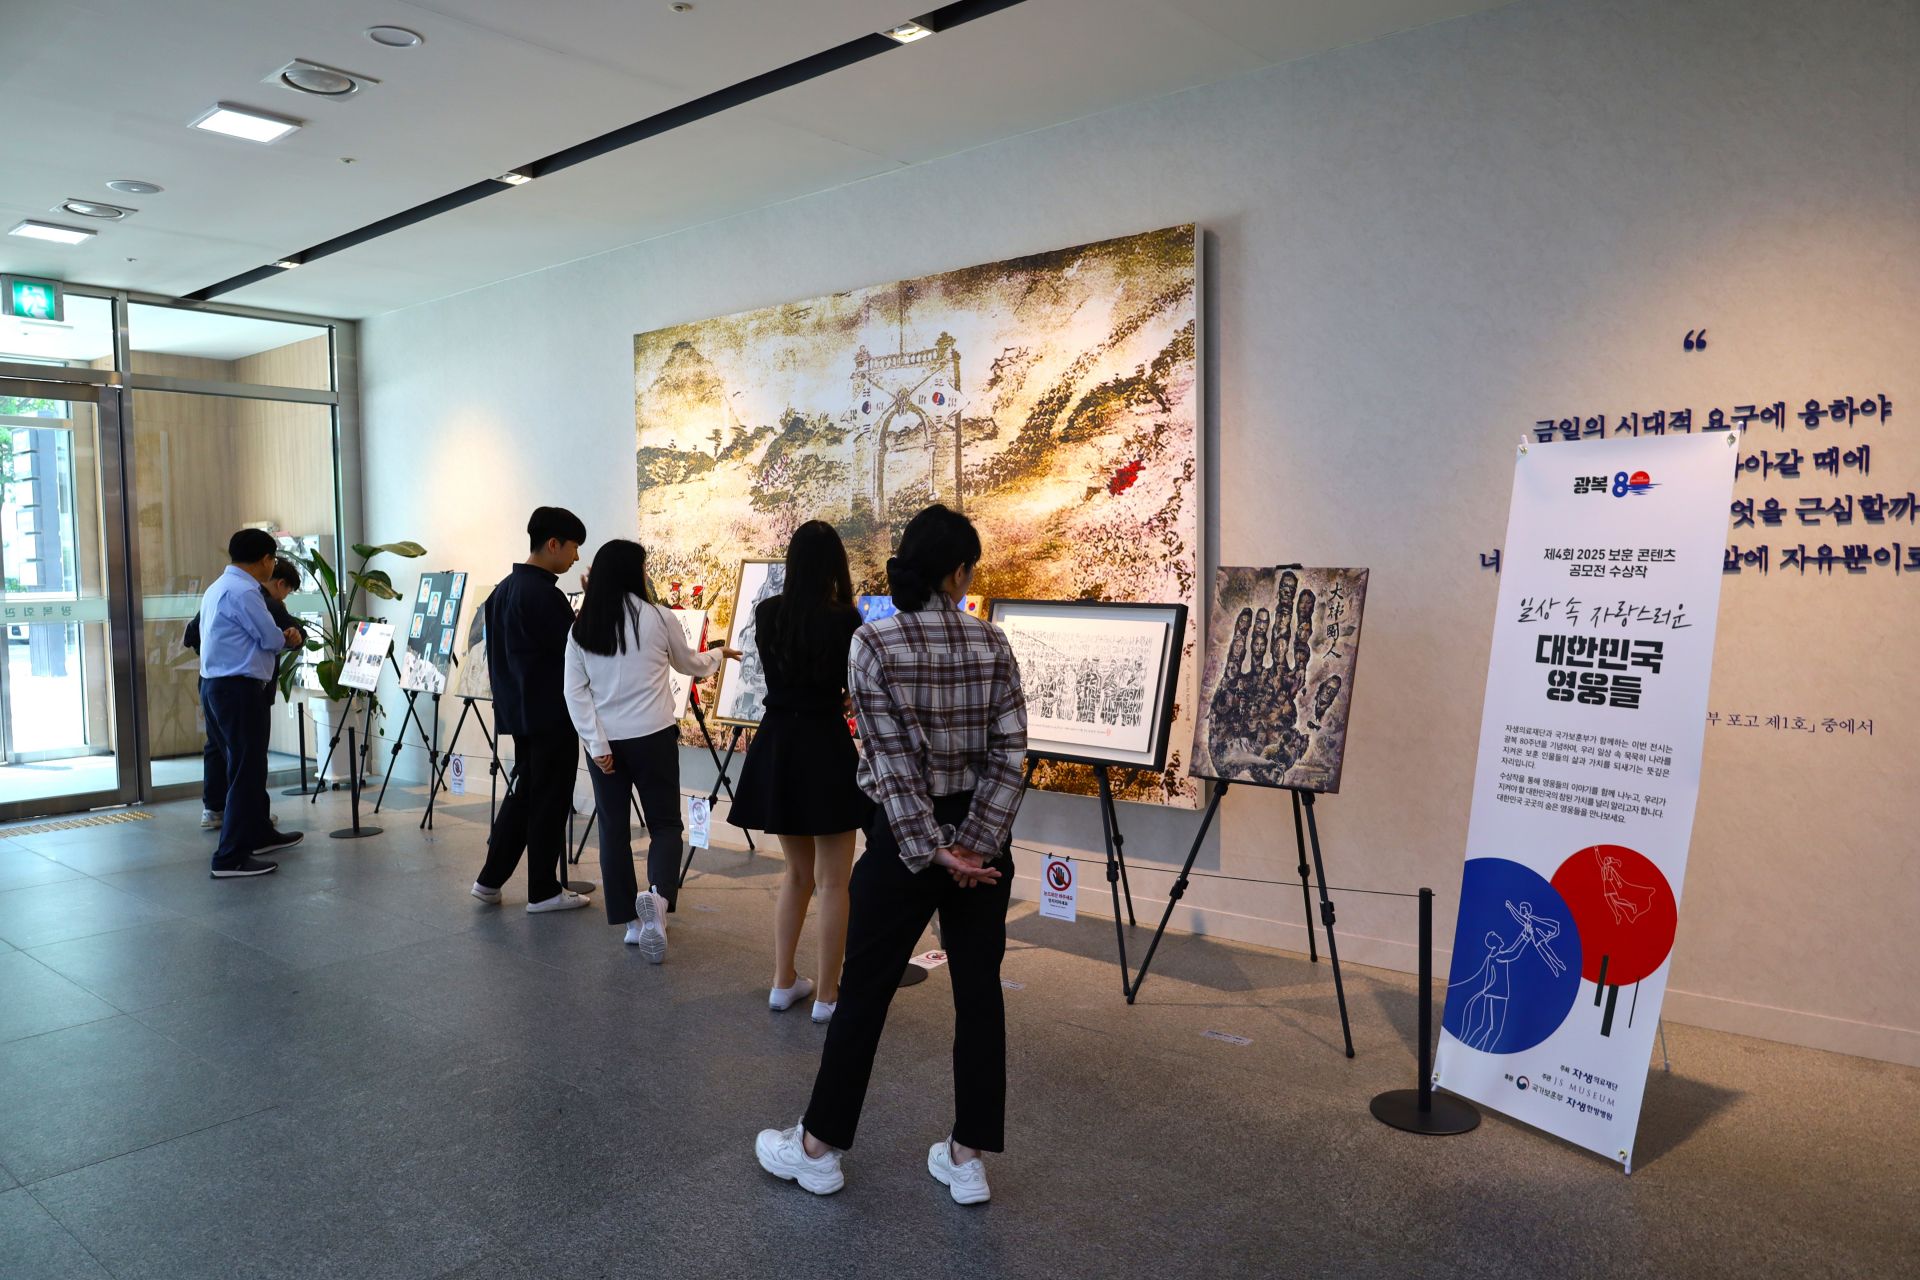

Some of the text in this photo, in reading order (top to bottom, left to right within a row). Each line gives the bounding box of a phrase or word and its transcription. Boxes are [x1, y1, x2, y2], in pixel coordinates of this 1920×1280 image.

[1533, 394, 1892, 443] 금일의 시대적 요구에 응하야
[1813, 444, 1870, 476] 때에
[1574, 476, 1607, 494] 광복
[1544, 548, 1676, 562] 제4회 2025 보훈 콘텐츠
[1569, 564, 1648, 578] 공모전 수상작
[1517, 597, 1692, 629] 일상 속 자랑스러운
[1535, 634, 1664, 674] 대한민국
[1546, 669, 1642, 709] 영웅들
[1505, 724, 1673, 754] 자생의료재단과 국가보훈부가 함께하는 이번 전시는
[1727, 714, 1760, 727] 포고
[1821, 718, 1874, 736] 중에서
[1503, 746, 1523, 756] 지켜온
[1526, 749, 1539, 758] 보훈
[1541, 751, 1569, 763] 인물들의
[1589, 758, 1610, 769] 가치를
[1613, 762, 1643, 774] 되새기는
[1647, 766, 1670, 778] 뜻깊은
[1504, 735, 1518, 744] 광복
[1520, 738, 1547, 748] 80주년을
[1581, 745, 1595, 755] 우리
[1598, 747, 1612, 757] 일상
[1614, 750, 1621, 759] 속
[1624, 751, 1646, 762] 묵묵히
[1649, 755, 1672, 766] 나라를
[1496, 793, 1523, 805] 대한민국
[1524, 798, 1544, 808] 곳곳의
[1560, 804, 1587, 817] 영웅들을
[1498, 782, 1518, 793] 지켜야
[1526, 787, 1558, 800] 대한민국의
[1574, 795, 1594, 806] 가치를
[1611, 801, 1639, 814] 알리고자
[1500, 772, 1525, 783] 수상작을
[1528, 776, 1540, 785] 통해
[1542, 779, 1569, 790] 영웅들의
[1571, 783, 1599, 795] 이야기를
[1601, 788, 1616, 798] 함께
[1644, 794, 1666, 807] 우리가
[1569, 1083, 1615, 1107] MUSEUM
[1572, 1068, 1618, 1092] 자생의료재단
